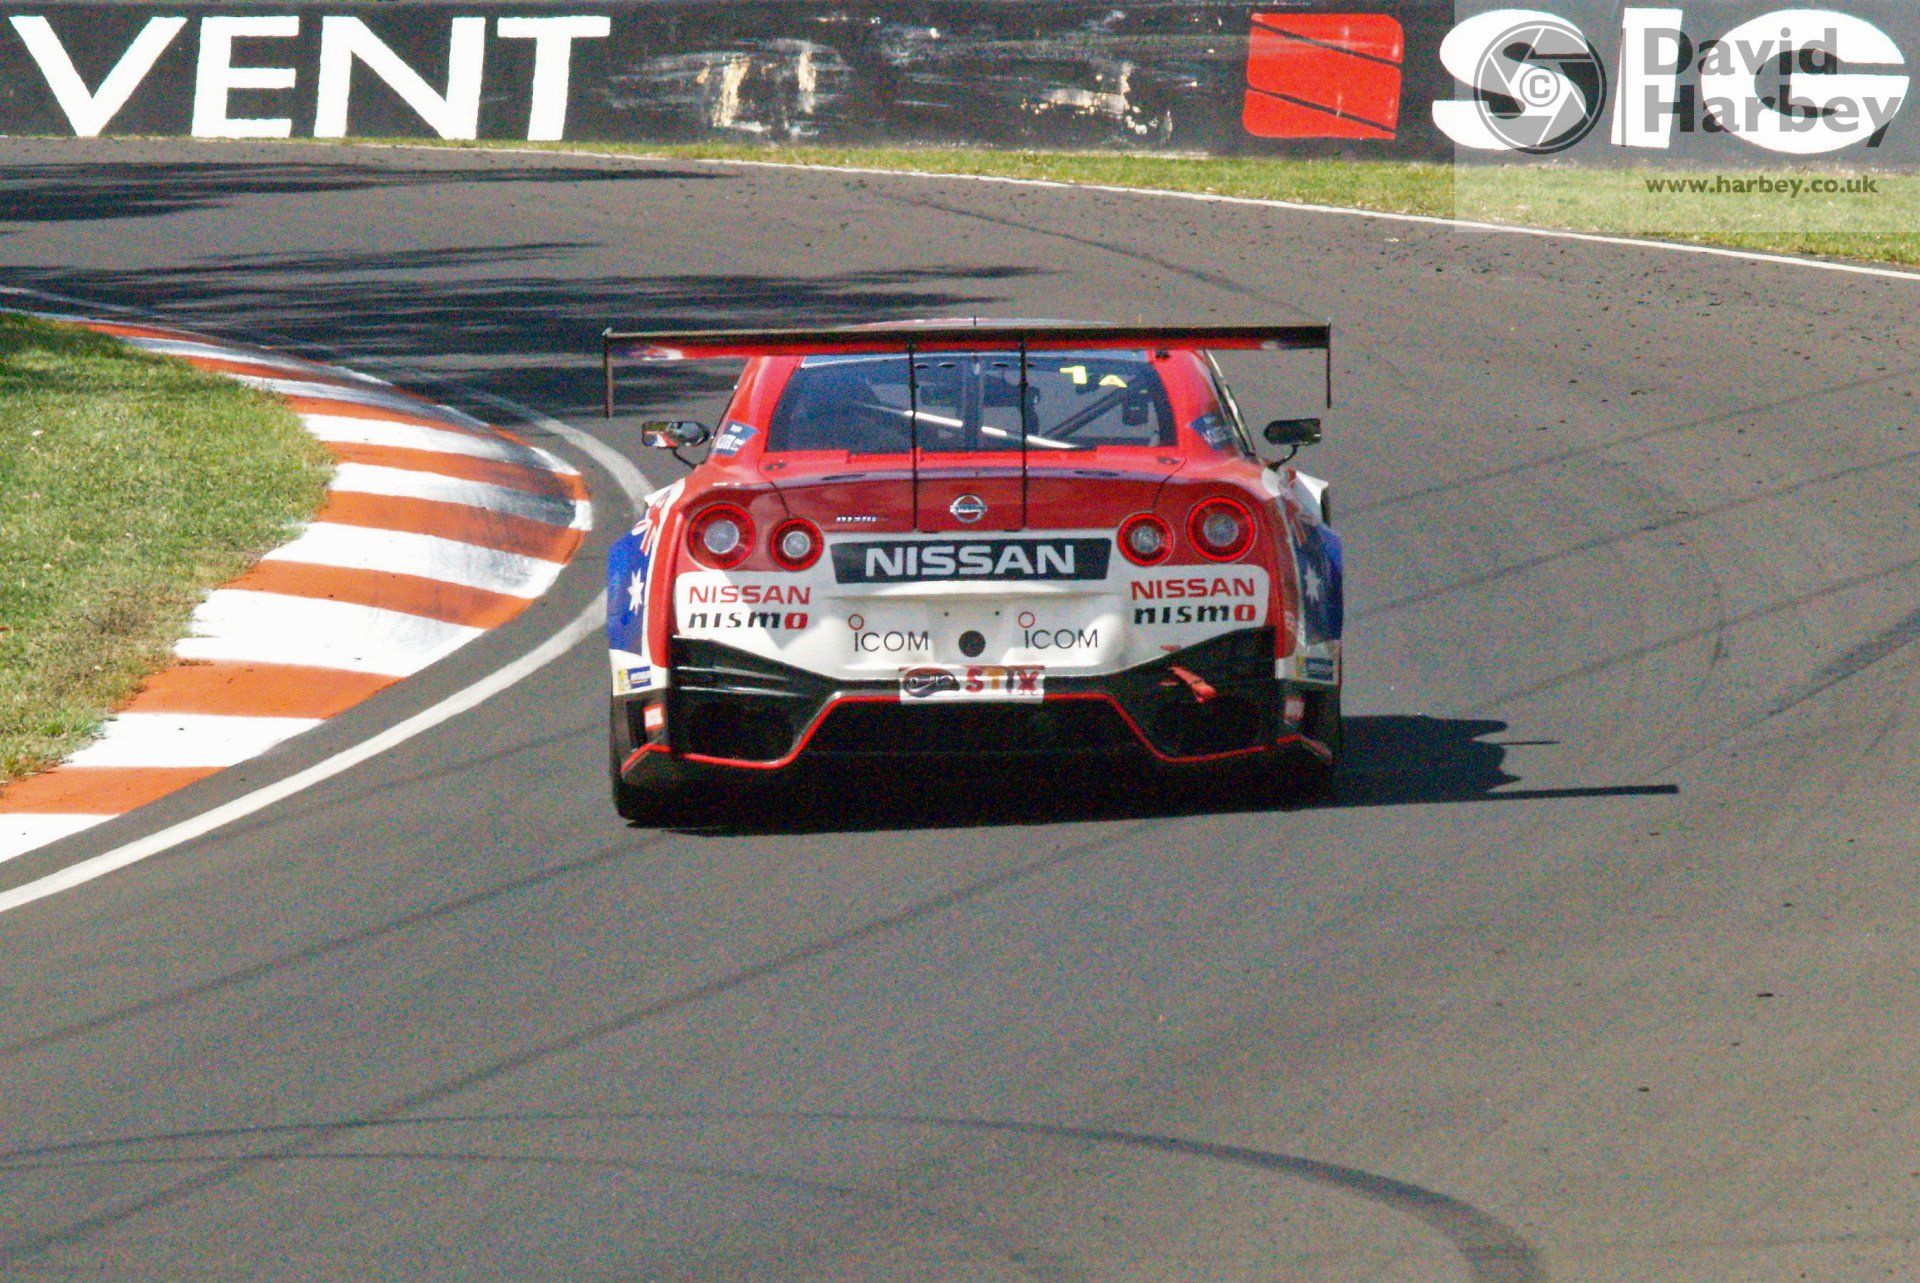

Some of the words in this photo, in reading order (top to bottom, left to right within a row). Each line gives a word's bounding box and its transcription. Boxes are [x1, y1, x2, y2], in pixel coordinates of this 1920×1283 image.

[9, 15, 611, 141] VENT
[1432, 8, 1909, 153] SIG
[865, 544, 1076, 577] NISSAN
[688, 585, 811, 606] NISSAN
[1131, 577, 1255, 601] NISSAN
[688, 611, 808, 630] nismo
[1134, 603, 1255, 625] nismo
